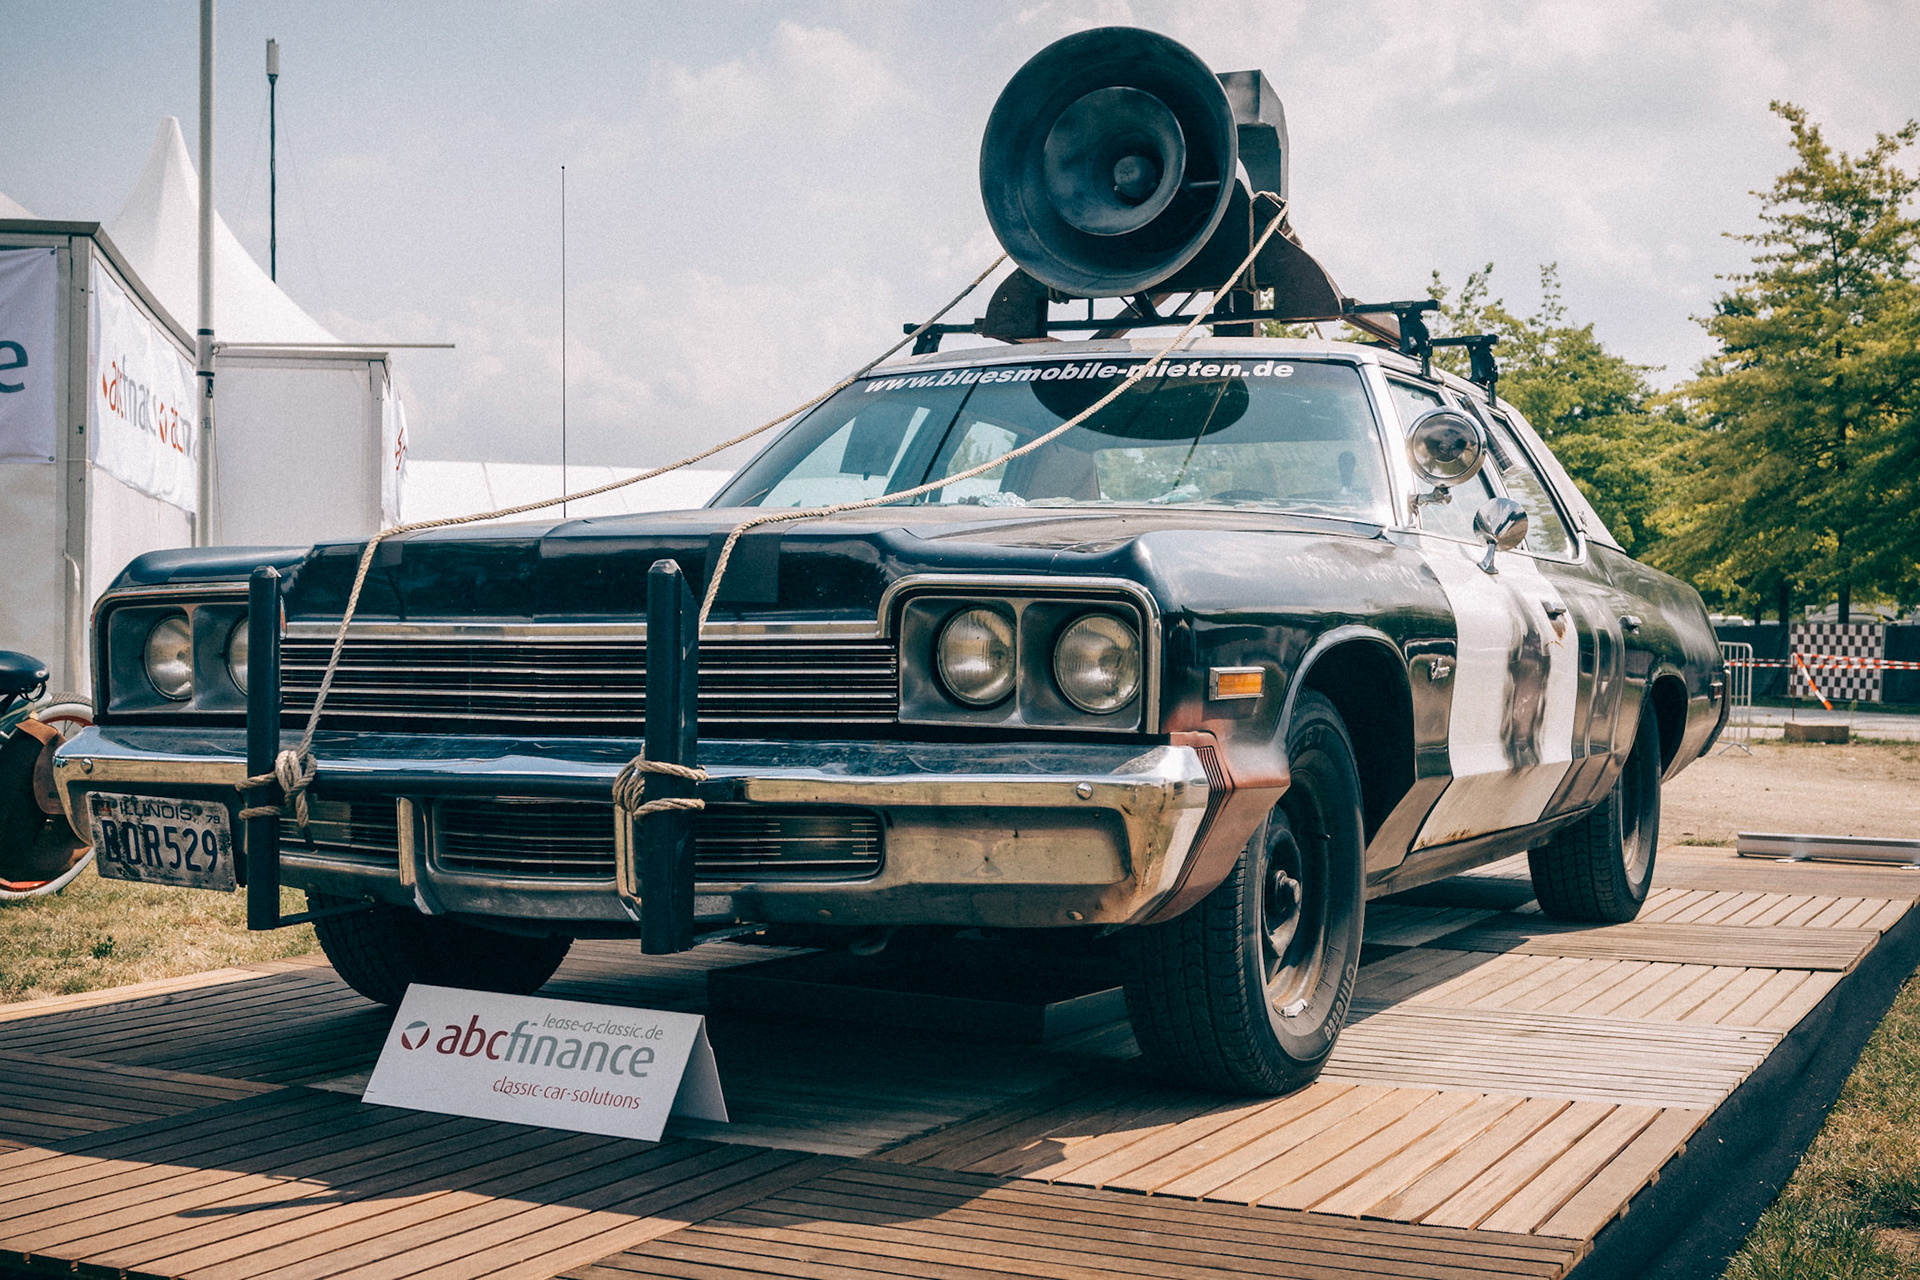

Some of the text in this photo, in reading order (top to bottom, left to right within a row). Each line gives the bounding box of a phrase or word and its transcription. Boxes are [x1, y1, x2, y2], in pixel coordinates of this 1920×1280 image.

[119, 800, 193, 821] ILLINOIS
[542, 1012, 664, 1041] lease-a-classic.de
[435, 1014, 656, 1078] abcfinance
